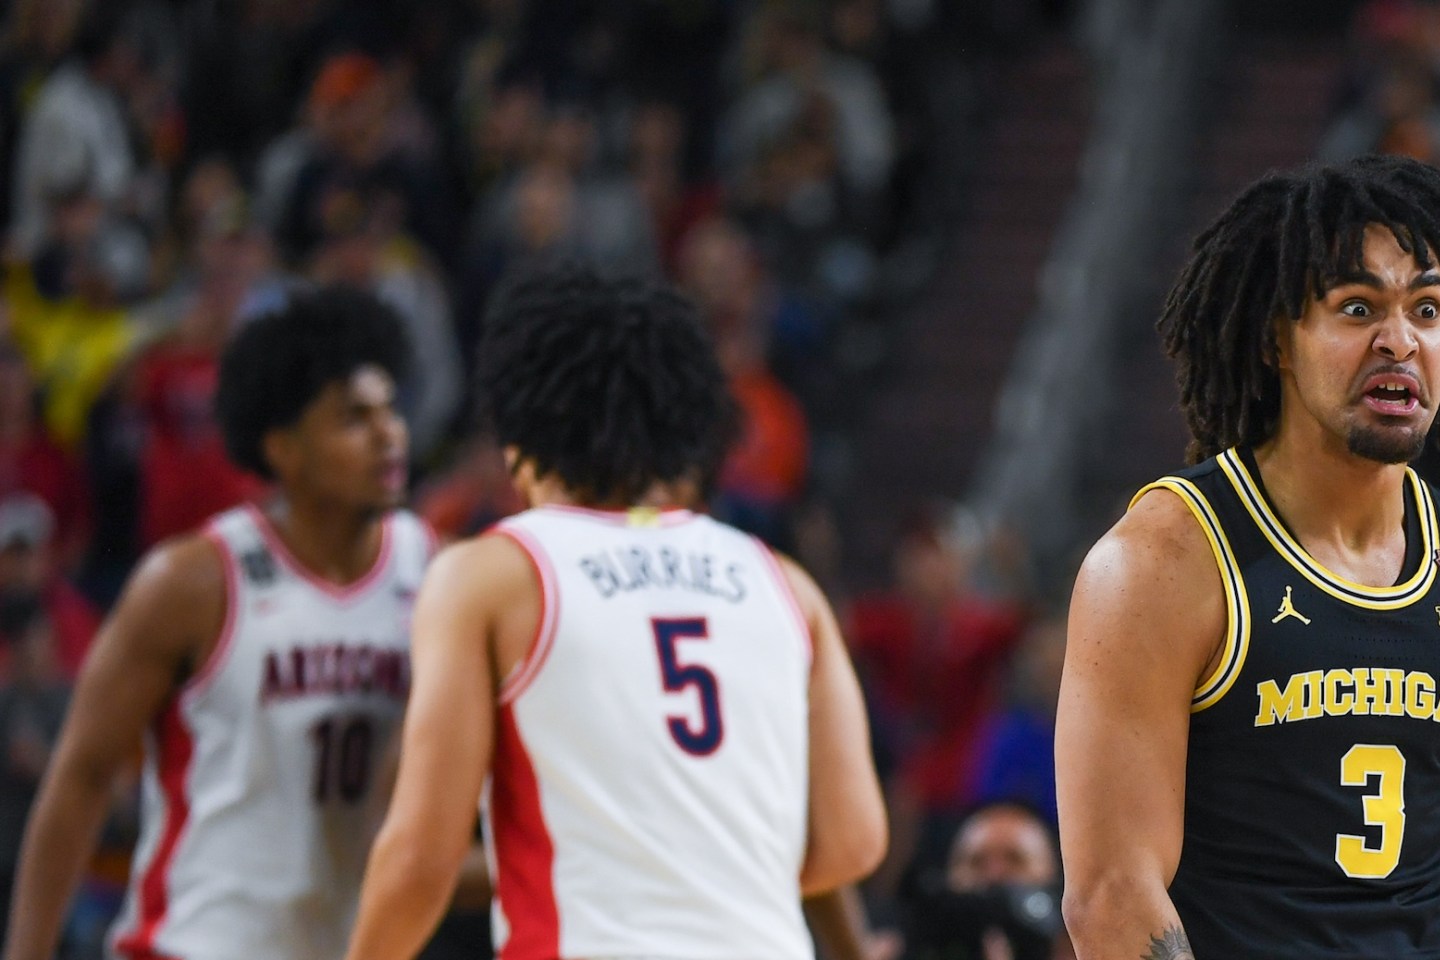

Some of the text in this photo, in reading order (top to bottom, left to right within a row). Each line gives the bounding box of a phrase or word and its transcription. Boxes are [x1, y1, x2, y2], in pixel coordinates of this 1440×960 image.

[579, 545, 747, 604] BURRIES
[261, 640, 412, 705] ARIZON
[649, 616, 724, 759] 5
[312, 715, 373, 806] 10
[1335, 743, 1406, 879] 3
